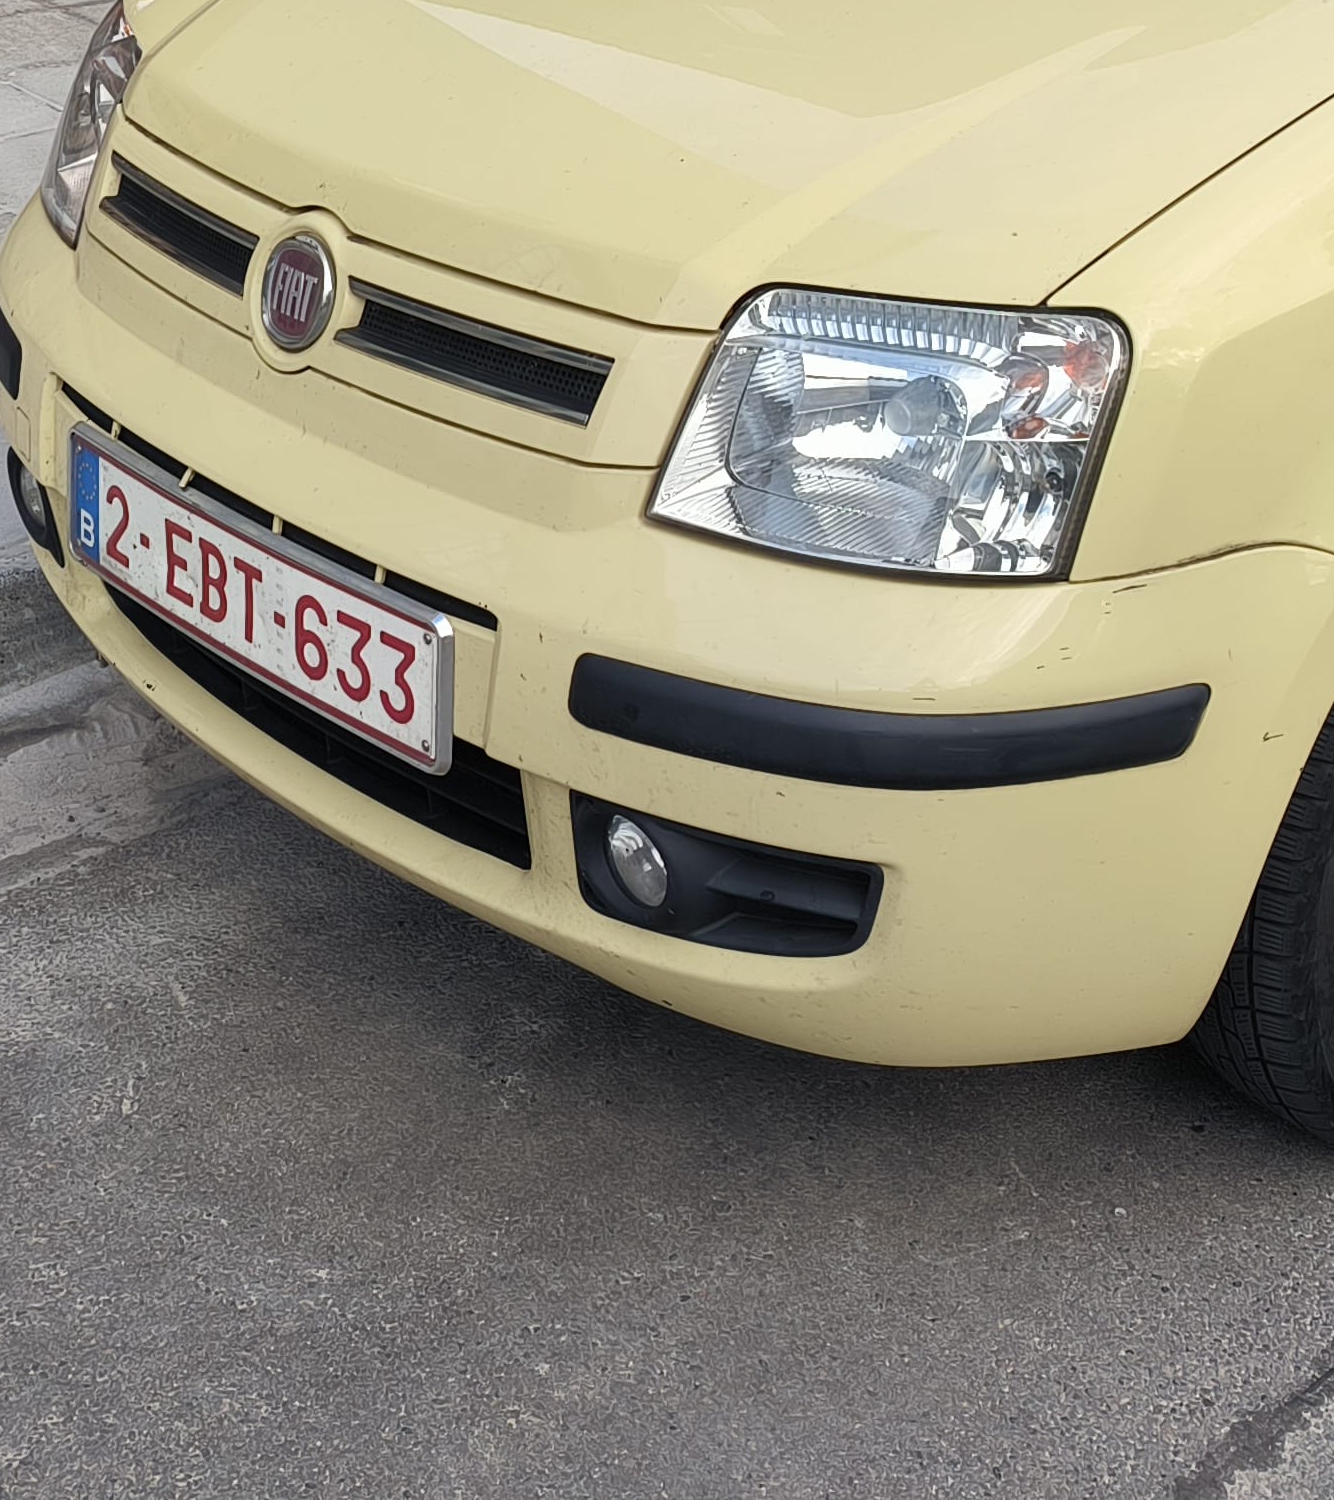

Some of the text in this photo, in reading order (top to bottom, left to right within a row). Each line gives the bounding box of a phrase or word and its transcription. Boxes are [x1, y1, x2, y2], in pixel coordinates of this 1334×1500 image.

[273, 263, 318, 323] FIAT
[80, 508, 95, 548] B
[106, 485, 416, 725] 2-EBT-633
